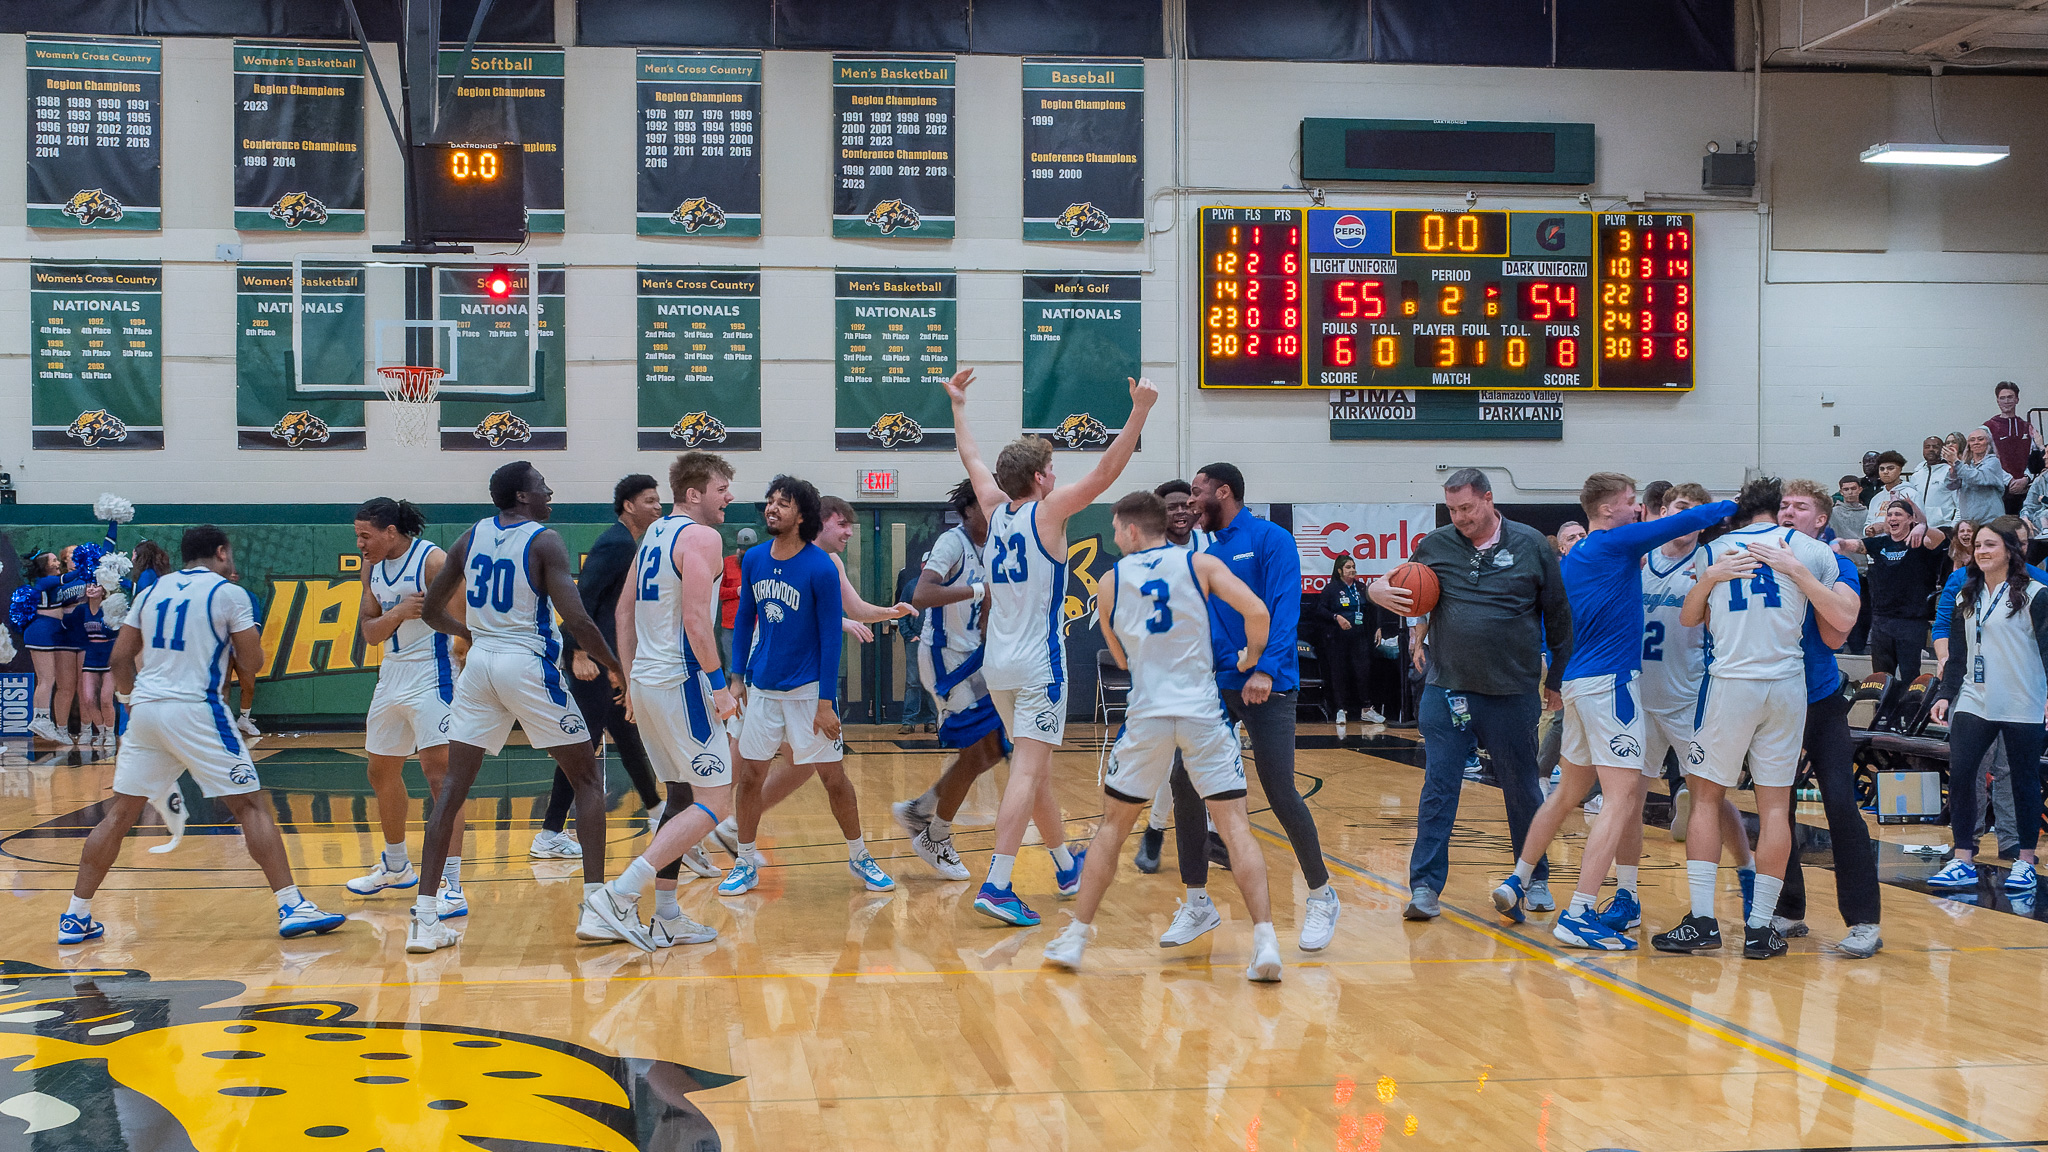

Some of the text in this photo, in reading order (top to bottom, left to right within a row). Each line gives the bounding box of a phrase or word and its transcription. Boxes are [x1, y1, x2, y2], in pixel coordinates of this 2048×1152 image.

[36, 50, 152, 63] Women's Cross Country
[243, 56, 356, 68] Women's Basketball
[471, 58, 532, 71] Softball
[645, 64, 752, 76] Men's Cross Country
[841, 68, 947, 79] Men's Basketball
[1052, 71, 1114, 83] Baseball
[47, 79, 140, 92] Region Champions
[254, 84, 344, 97] Region Champions
[458, 87, 545, 98] Region Champions
[656, 92, 742, 103] Region Champions
[243, 101, 268, 111] 2023
[852, 95, 937, 107] Region Champions
[1041, 99, 1126, 111] Region Champions
[1031, 116, 1053, 126] 1999
[36, 135, 150, 148] 2004 2011 2012 2013
[243, 139, 356, 152] Conference Champions
[842, 136, 892, 146] 2018 2023
[36, 147, 59, 158] 2014
[842, 149, 948, 161] Conference Champions
[1031, 153, 1137, 163] Conference Champions
[243, 157, 295, 168] 1998 2014
[453, 152, 495, 178] 0.0
[645, 158, 667, 168] 2016
[1031, 169, 1082, 179] 1999 2000
[842, 179, 865, 189] 2023
[1212, 209, 1291, 221] PLYR FLS PTS
[1605, 215, 1682, 226] PLYR FLS PTS
[1232, 228, 1296, 244] 1 1 1
[1336, 227, 1364, 235] PEPSI
[1424, 215, 1478, 250] 0.0
[1620, 231, 1687, 250] 3 1 17
[1218, 253, 1296, 273] 12 2 6
[1315, 260, 1396, 273] LIGHT UNIFORM
[1506, 262, 1585, 276] DARK UNIFORM
[1612, 258, 1687, 277] 10 3 14
[37, 274, 157, 286] Women's Cross Country
[243, 276, 293, 286] Women's
[1432, 270, 1471, 282] PERIOD
[642, 279, 754, 291] Men's Cross Country
[850, 282, 942, 292] Men's Basketball
[1055, 283, 1109, 294] Men's Golf
[1218, 281, 1296, 300] 14 2 3
[1338, 282, 1381, 317] 55
[1605, 284, 1687, 304] 22 1 3
[53, 300, 140, 312] NATIONALS
[1444, 287, 1459, 314] 2
[1533, 285, 1574, 319] 54
[461, 304, 544, 314] NATIONAS
[658, 304, 740, 316] NATIONALS
[855, 307, 936, 318] NATIONALS
[1042, 308, 1121, 319] NATIONALS
[1210, 307, 1296, 327] 23 0 8
[1605, 311, 1687, 331] 24 3 8
[1323, 323, 1357, 334] FOULS
[1371, 324, 1400, 335] T.O.L.
[1413, 324, 1490, 336] PLAYER FOUL
[1501, 325, 1530, 336] T.O.L.
[1546, 325, 1580, 336] FOULS
[1212, 335, 1296, 355] 30 2 10
[1336, 338, 1351, 364] 6
[1605, 338, 1687, 358] 30 3 6
[1378, 338, 1393, 365] 0
[1508, 339, 1524, 366] 0
[1560, 340, 1574, 366] 8
[1321, 373, 1358, 384] SCORE
[1432, 373, 1470, 384] MATCH
[1544, 374, 1580, 385] SCORE
[1341, 390, 1408, 403] PIMA
[1481, 391, 1561, 402] Kalamazoo Valley
[1332, 407, 1413, 419] KIRKWOOD
[1483, 407, 1562, 420] PARKLAND
[868, 472, 891, 490] EXIT
[992, 533, 1028, 583] 23
[467, 553, 515, 613] 30
[1729, 562, 1781, 611] 14
[752, 579, 801, 611] KIRKWOOD
[1140, 578, 1172, 634] 3
[151, 597, 191, 651] 11
[1861, 682, 1884, 690] DANVILLE
[3, 677, 28, 733] NOISE
